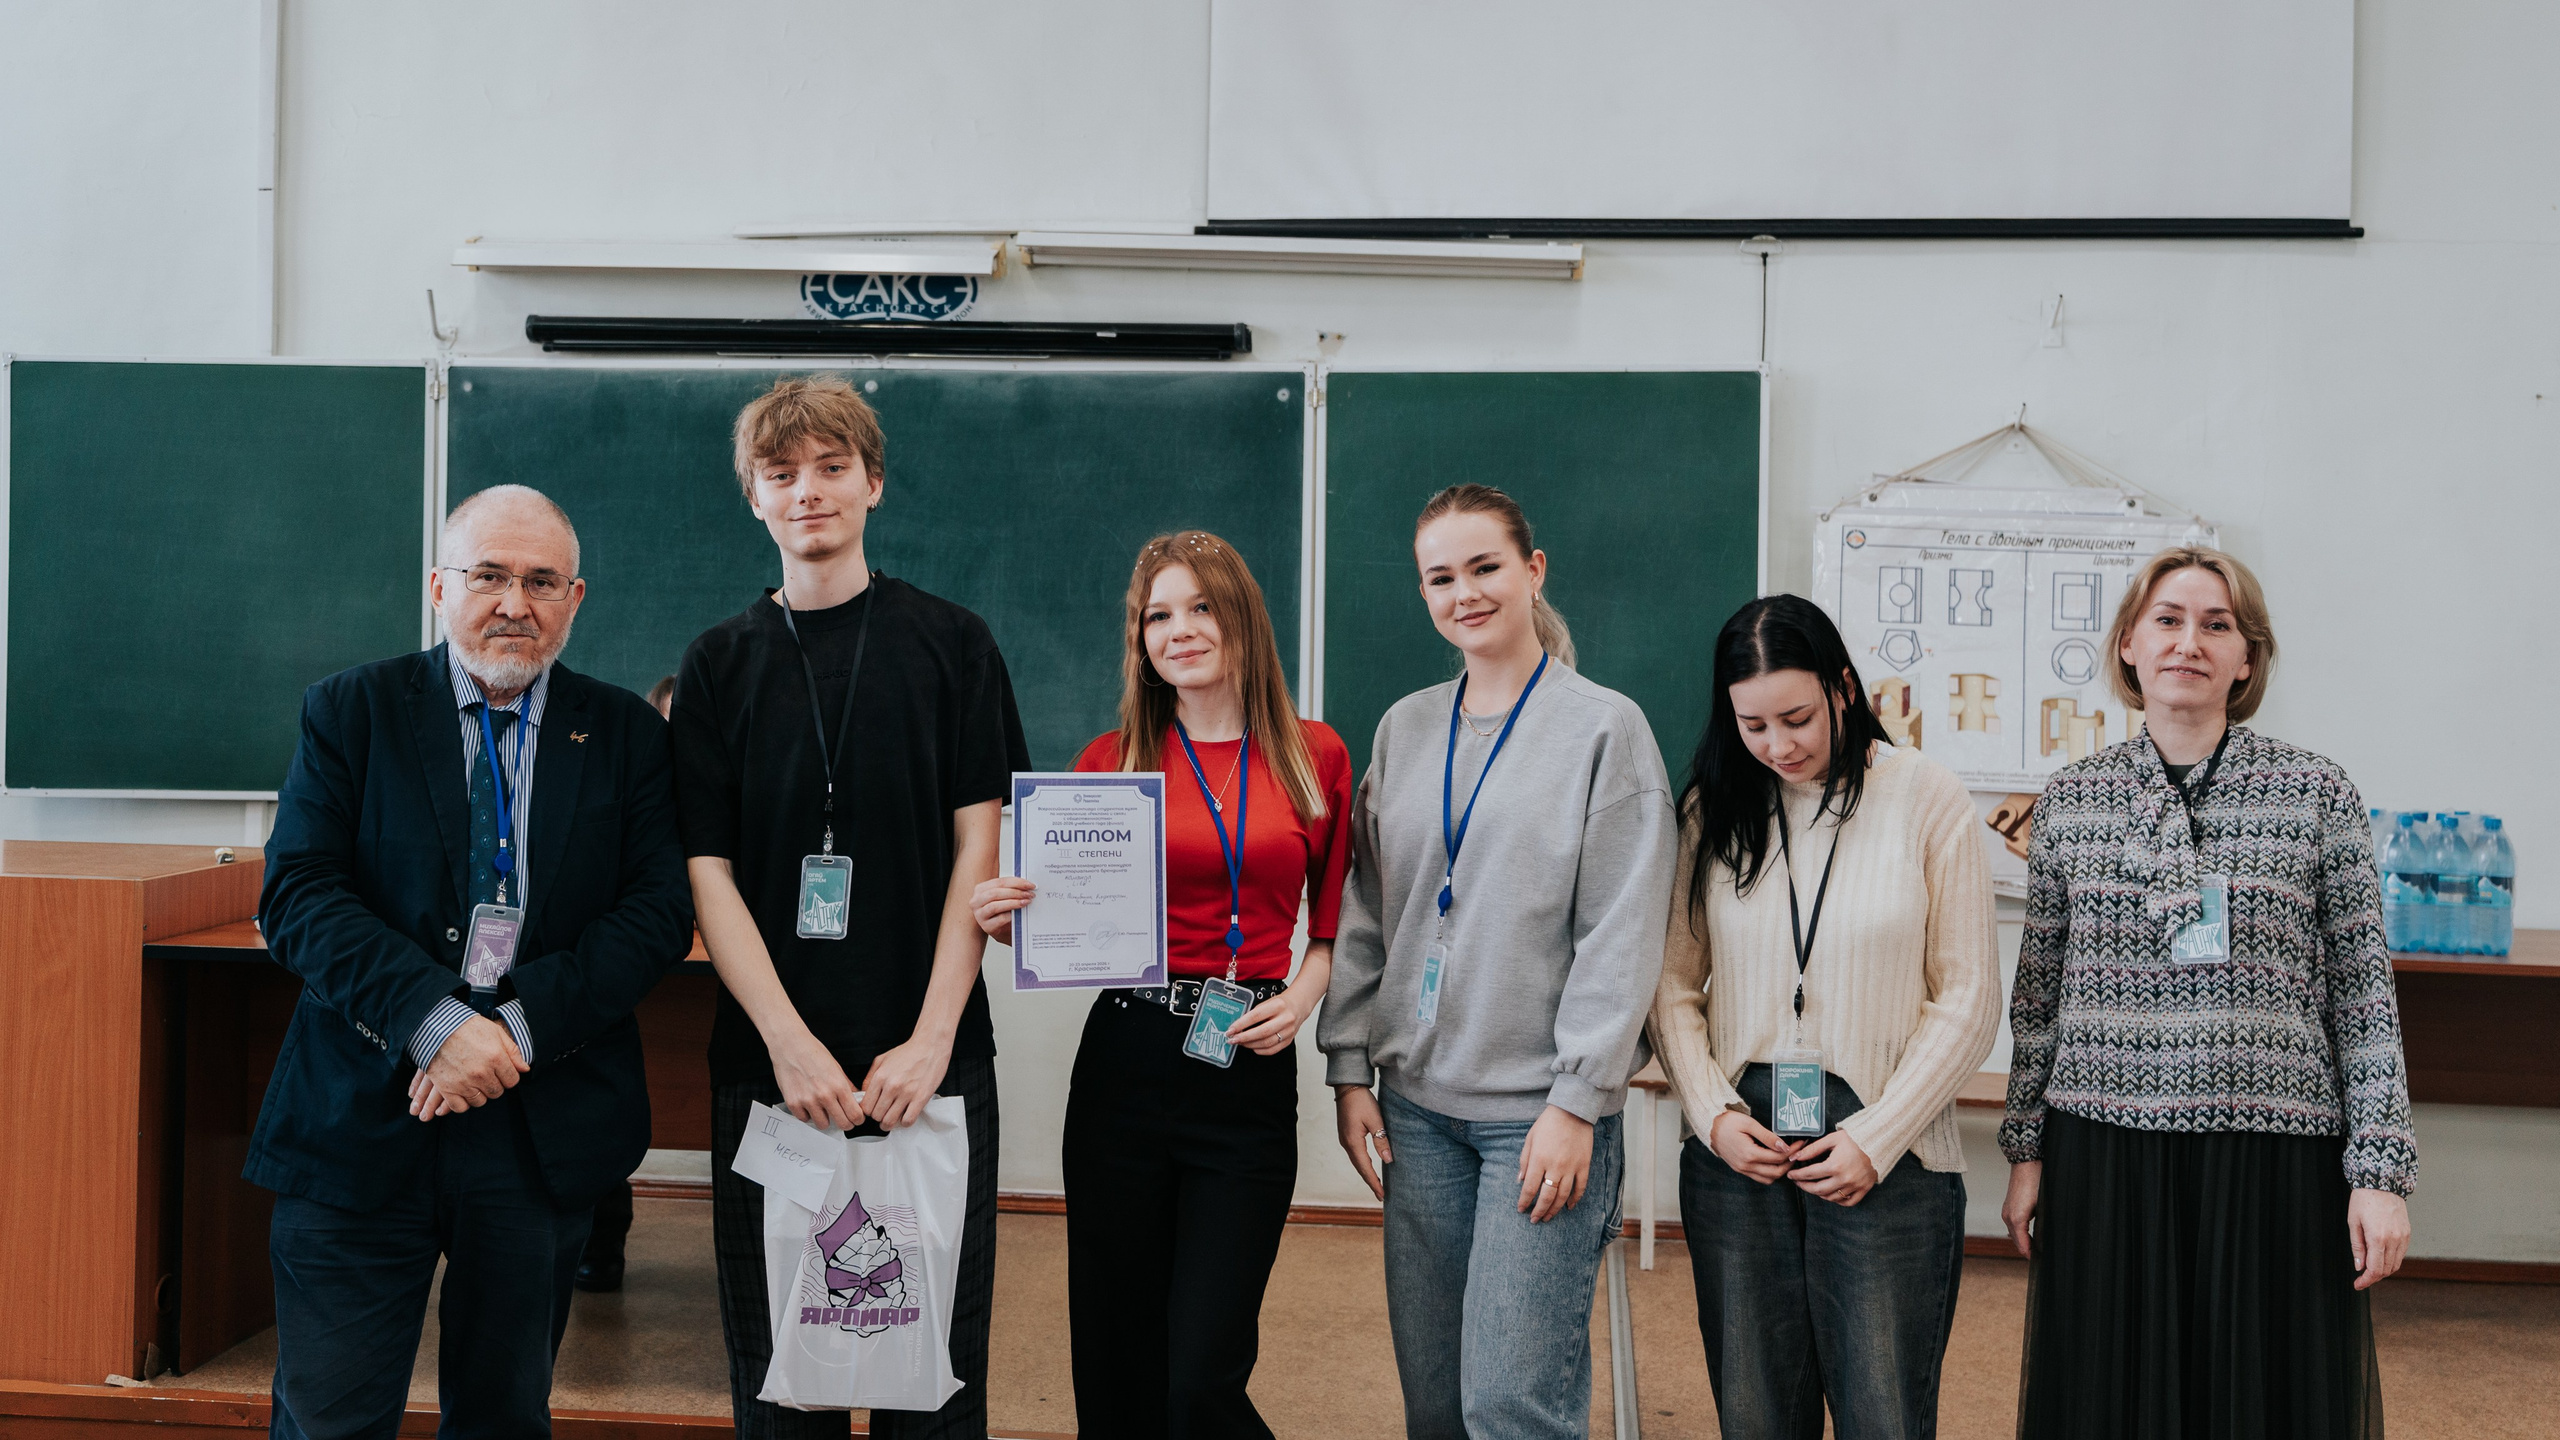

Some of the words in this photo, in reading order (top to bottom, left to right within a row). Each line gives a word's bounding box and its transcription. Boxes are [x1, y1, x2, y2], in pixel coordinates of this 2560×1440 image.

[825, 302, 952, 314] КРАСНОЯРСК
[1940, 530, 1970, 546] Тела
[1975, 534, 1984, 546] с
[1988, 531, 2044, 548] двойным
[2048, 538, 2136, 551] проницанием
[1918, 549, 1954, 562] Призма
[2093, 553, 2135, 567] Цилиндр
[1044, 829, 1132, 845] ДИПЛОМ
[1078, 850, 1122, 858] СТЕПЕНИ
[773, 1142, 812, 1168] МЕСТО
[800, 1306, 921, 1328] ЯРПИАР
